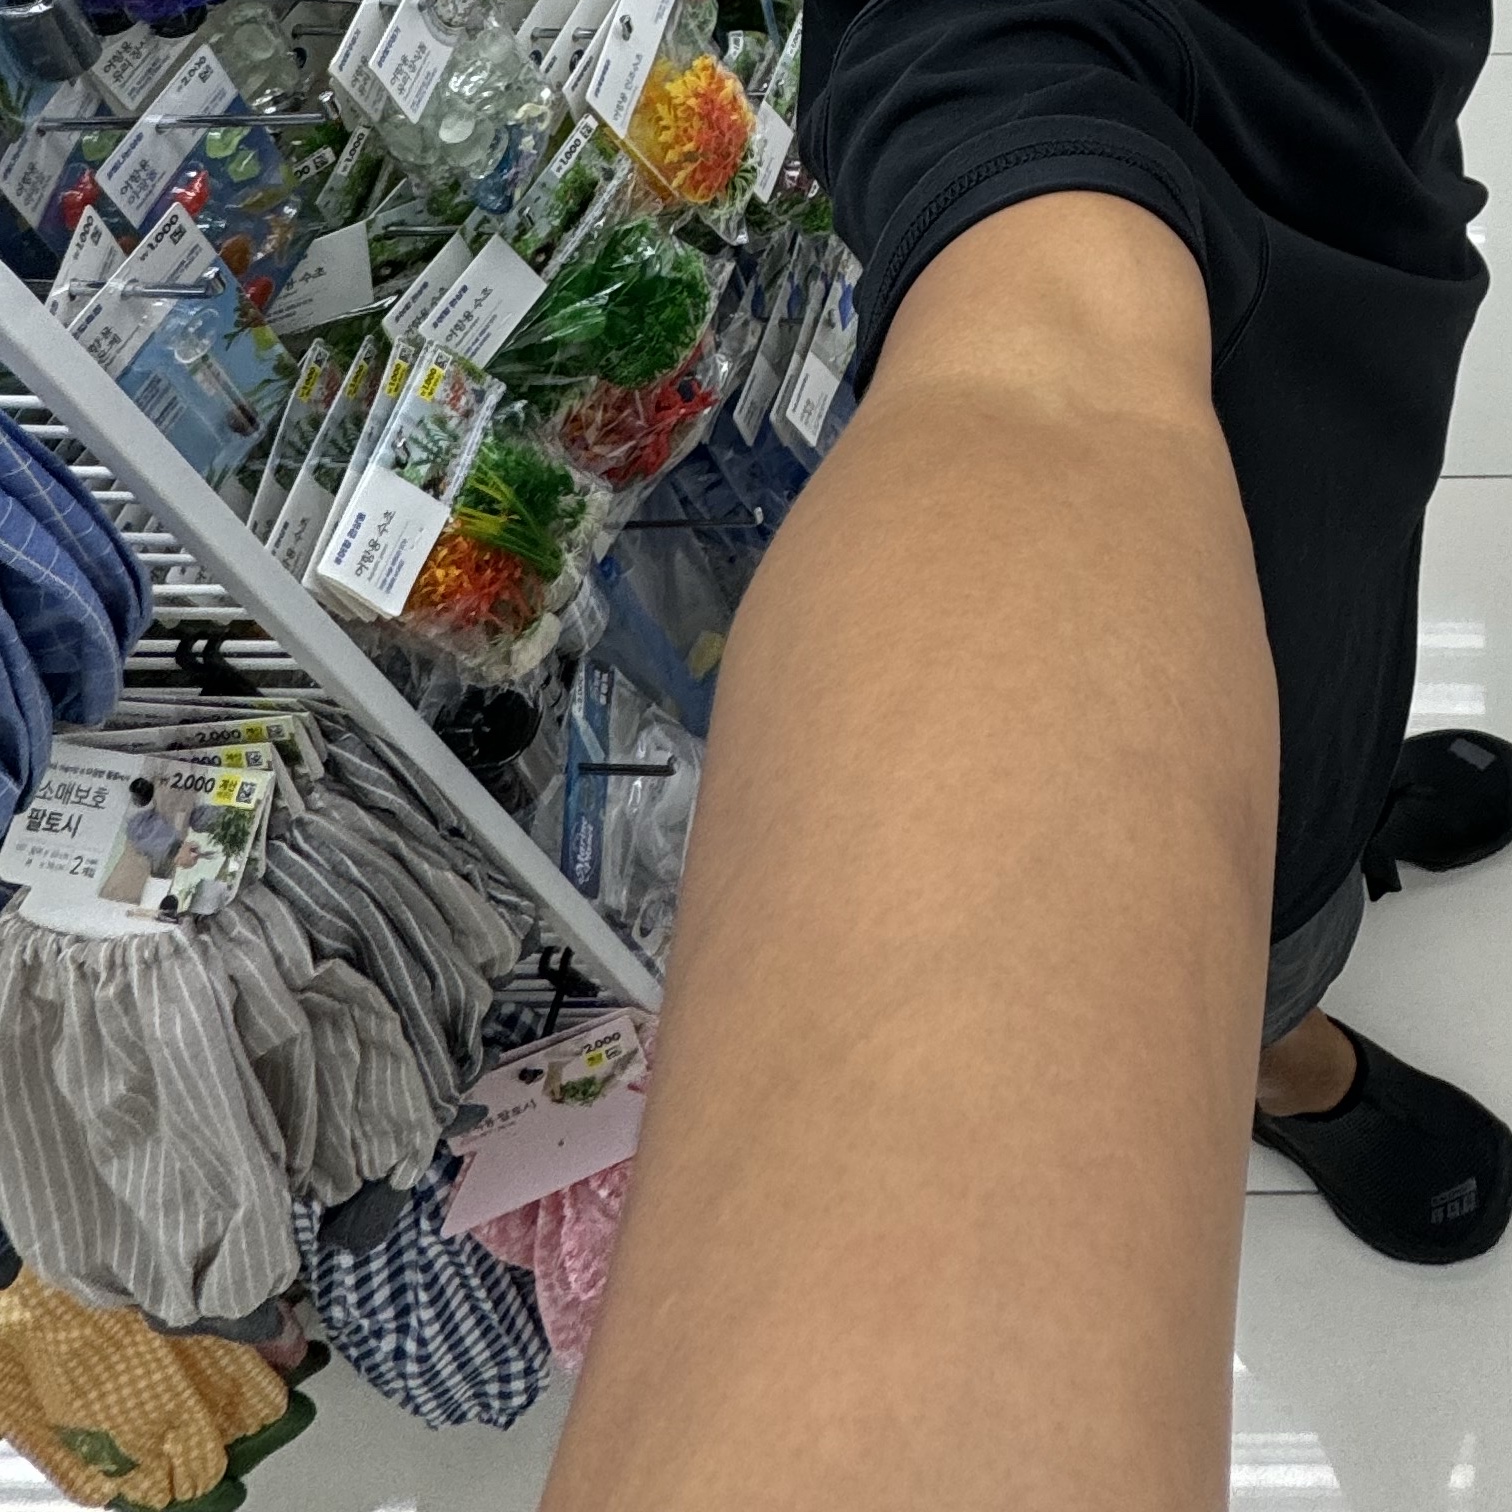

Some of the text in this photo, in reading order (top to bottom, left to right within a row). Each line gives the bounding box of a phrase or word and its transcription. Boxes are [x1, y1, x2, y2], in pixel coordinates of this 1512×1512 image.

[445, 285, 494, 343] 어항용 수초
[354, 509, 397, 578] 어항용 수초
[36, 780, 110, 810] 소매보호
[26, 806, 83, 839] 팔토시
